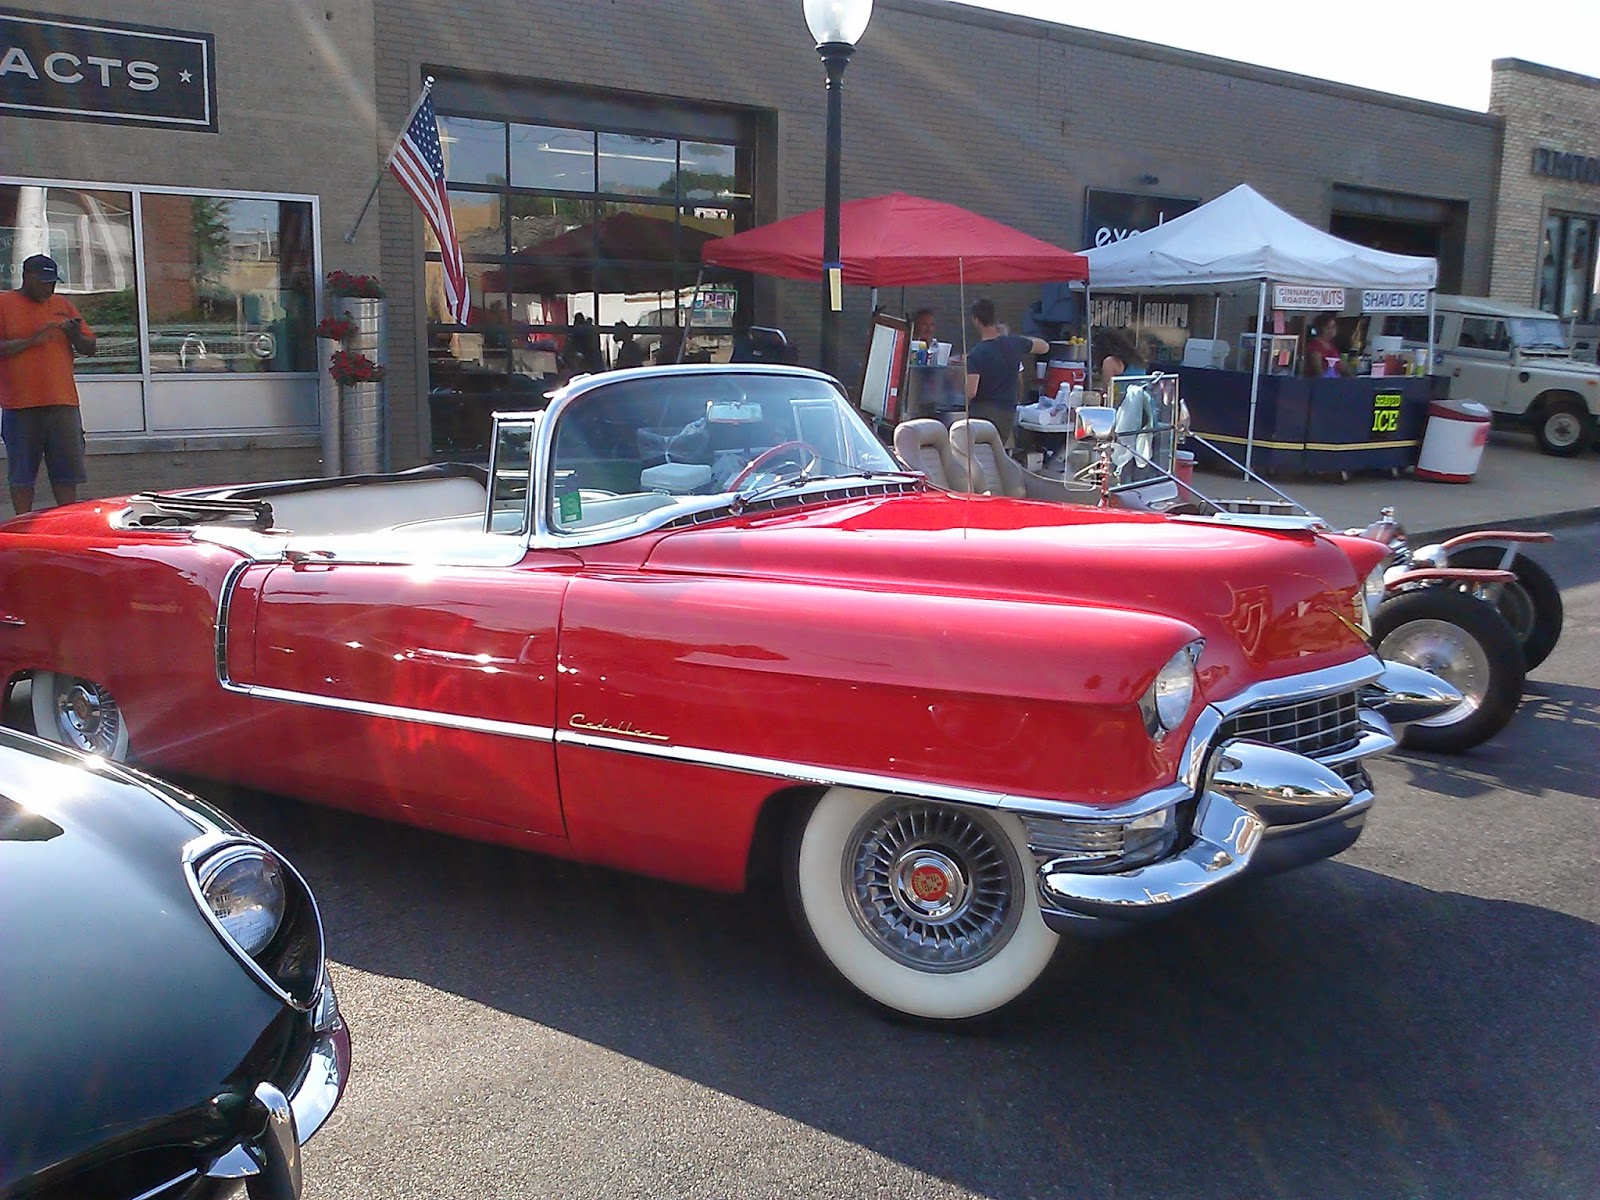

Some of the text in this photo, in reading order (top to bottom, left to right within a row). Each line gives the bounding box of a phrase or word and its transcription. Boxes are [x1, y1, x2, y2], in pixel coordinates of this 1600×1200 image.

[1279, 288, 1321, 297] CINNAMON
[1321, 290, 1343, 305] NUTS
[1364, 292, 1425, 308] SHAVED ICE
[1371, 409, 1399, 431] ICE
[569, 713, 670, 740] Cadillac
